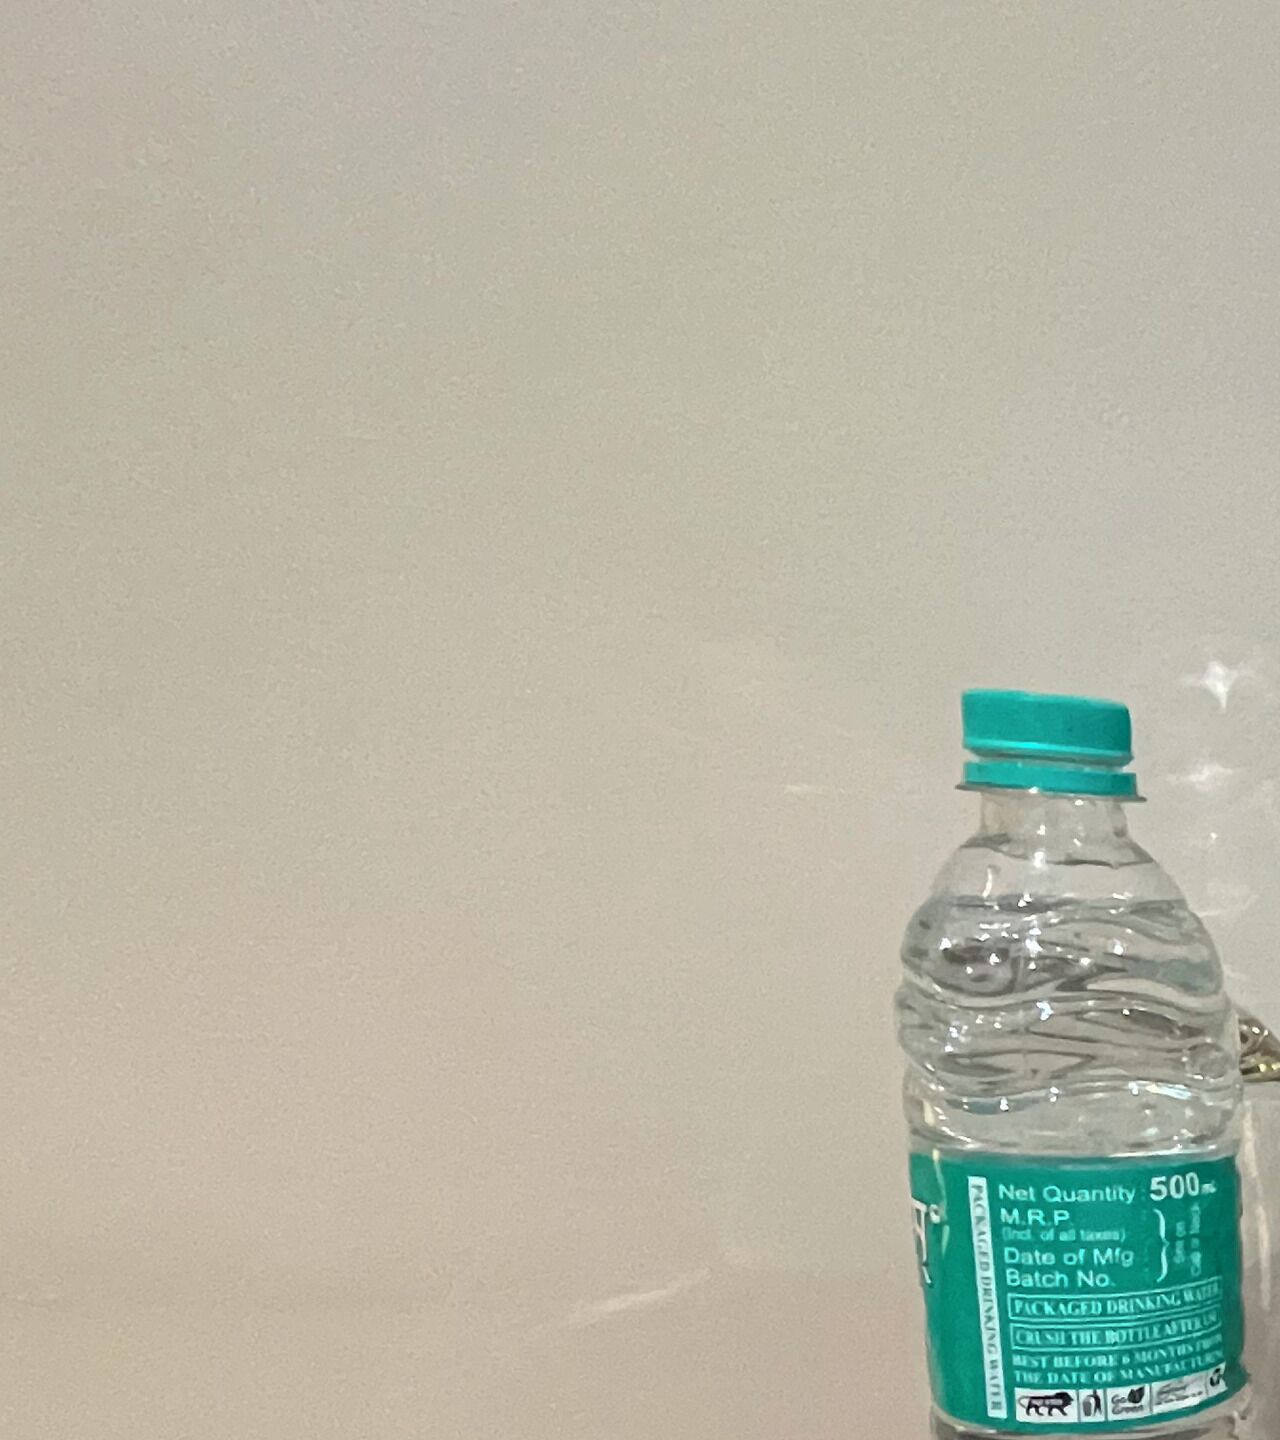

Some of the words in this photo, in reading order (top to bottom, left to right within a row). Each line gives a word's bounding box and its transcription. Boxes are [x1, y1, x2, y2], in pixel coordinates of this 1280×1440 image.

[998, 1184, 1034, 1202] Net
[1042, 1185, 1136, 1205] Quantity
[1150, 1171, 1200, 1201] 500
[1004, 1247, 1056, 1265] Date
[1063, 1248, 1086, 1265] of
[1093, 1248, 1134, 1268] Mfg
[1006, 1269, 1068, 1288] Batch
[1077, 1270, 1115, 1288] No.
[1014, 1300, 1102, 1316] PACKAGED
[1106, 1292, 1181, 1314] DRINKING
[1015, 1329, 1067, 1346] CRUSH
[1070, 1330, 1102, 1346] THE
[1105, 1324, 1163, 1346] BOTTLE
[1013, 1353, 1048, 1368] BEST
[1053, 1354, 1118, 1369] BEFORE
[1014, 1370, 1044, 1384] THE
[1048, 1370, 1087, 1384] DATE
[1093, 1370, 1115, 1384] OF
